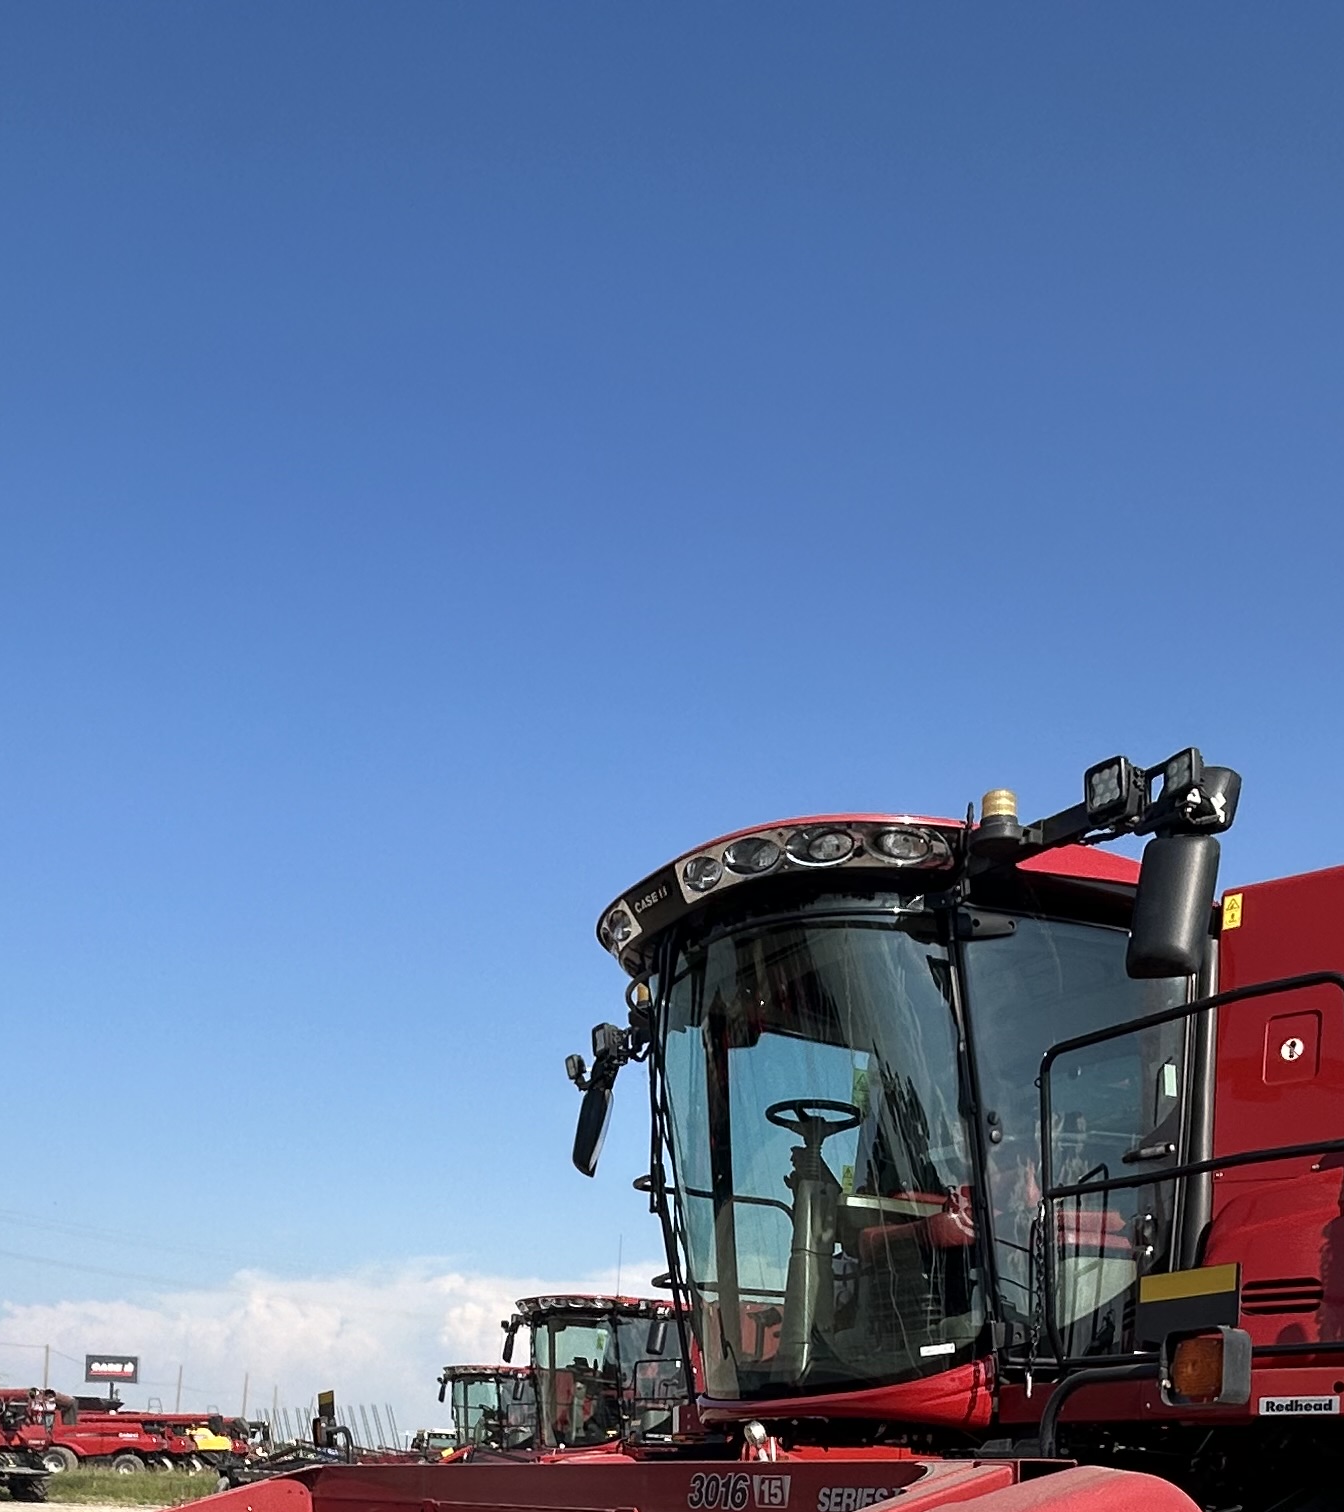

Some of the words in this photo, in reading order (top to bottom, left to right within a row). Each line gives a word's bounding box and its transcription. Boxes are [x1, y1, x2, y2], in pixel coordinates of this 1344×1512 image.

[634, 891, 659, 914] CASE
[1265, 1399, 1333, 1412] Redhead
[688, 1472, 750, 1511] 3016
[760, 1479, 783, 1504] 15
[817, 1486, 889, 1512] SERIES
